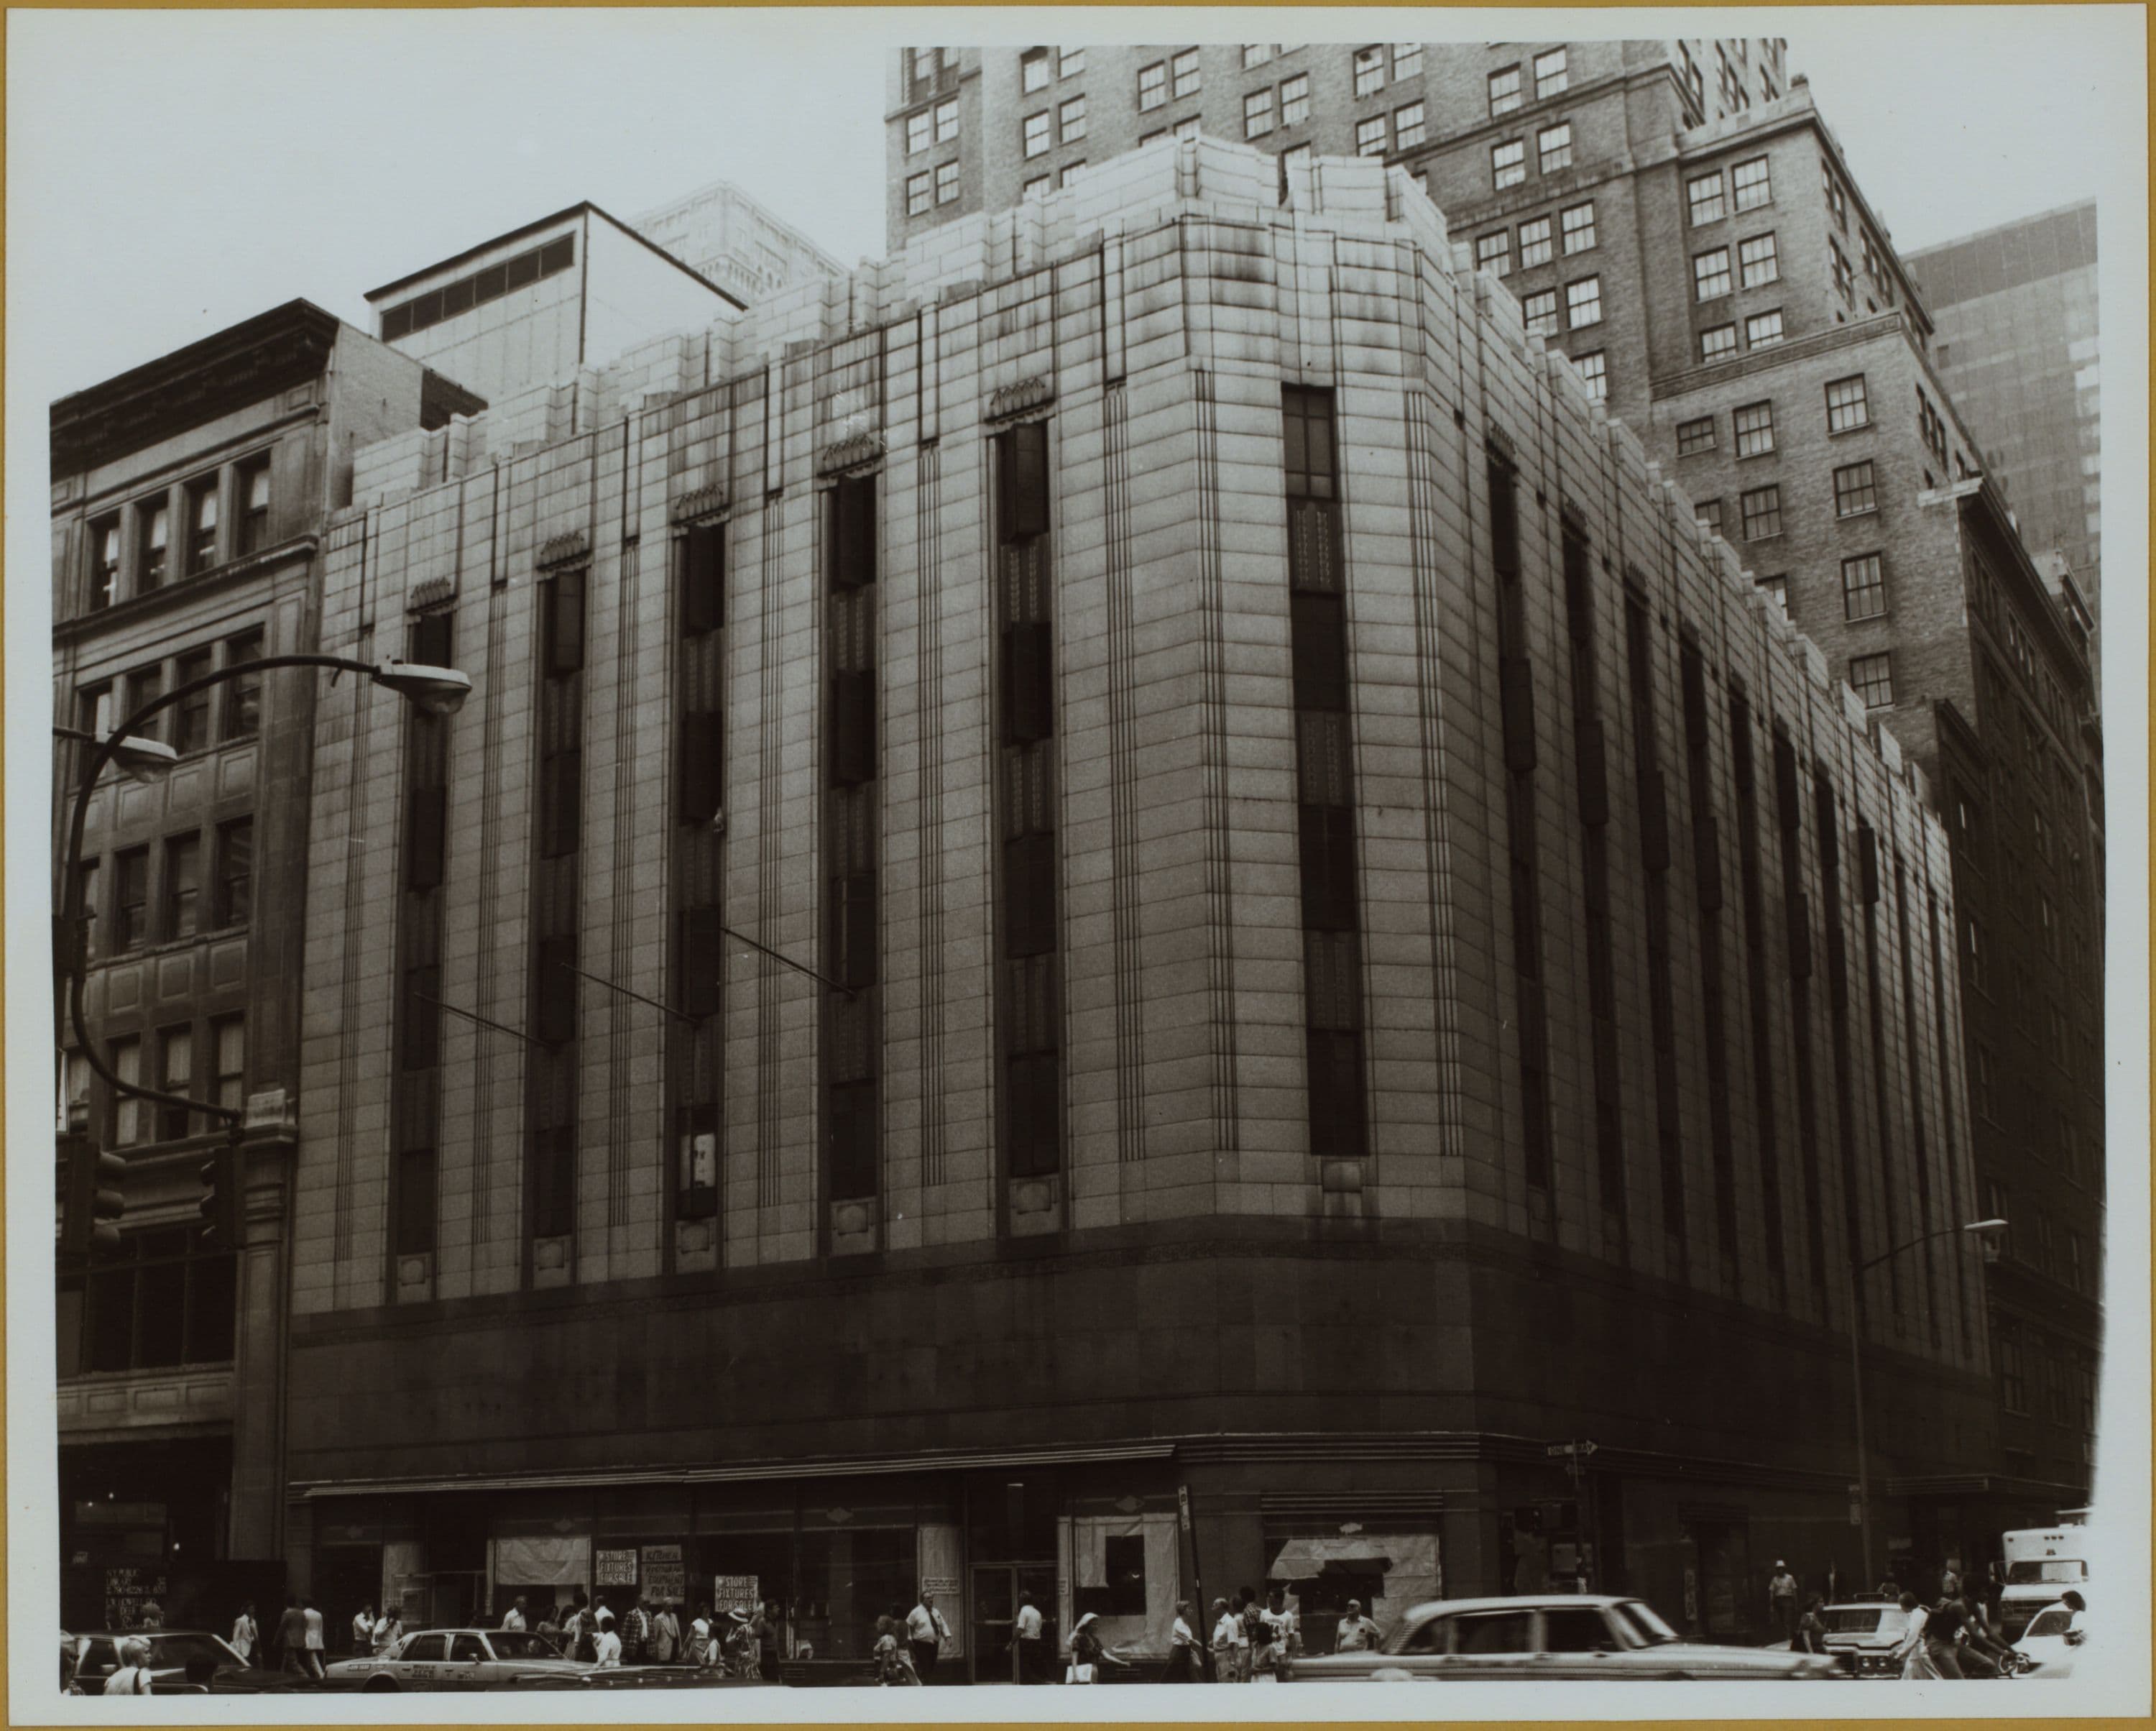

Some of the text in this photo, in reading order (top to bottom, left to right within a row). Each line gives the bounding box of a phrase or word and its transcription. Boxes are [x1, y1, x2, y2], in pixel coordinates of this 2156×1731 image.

[606, 1551, 627, 1561] STORE
[599, 1562, 632, 1572] FIXTURES
[601, 1572, 632, 1582] FOR SALE
[726, 1576, 747, 1587] STORE
[650, 1585, 685, 1597] FOR SALE
[717, 1587, 754, 1599] FIXTURES
[719, 1599, 753, 1611] FOR SALE
